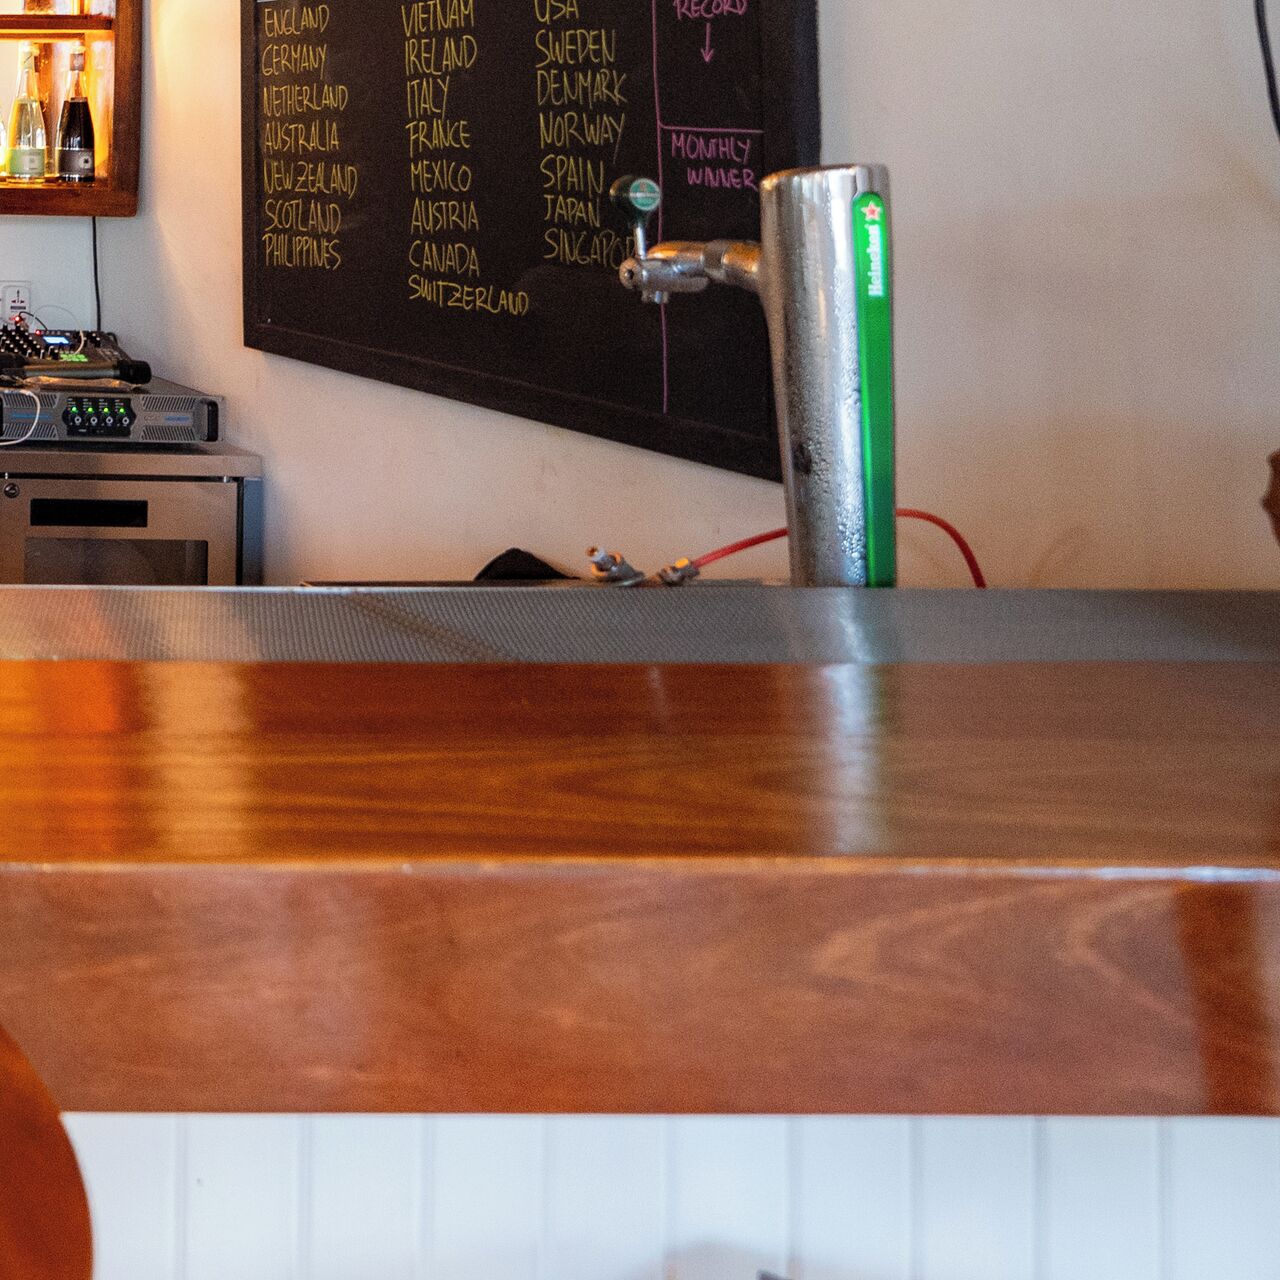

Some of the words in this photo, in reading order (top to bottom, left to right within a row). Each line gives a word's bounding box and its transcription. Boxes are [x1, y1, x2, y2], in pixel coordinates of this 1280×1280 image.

[264, 5, 330, 37] ENGLAND
[261, 43, 327, 80] GERMANY
[405, 35, 478, 76] IRELAND
[535, 29, 616, 68] SWEDEN
[263, 83, 349, 117] NETHERLAND
[407, 75, 450, 120] ITALY
[536, 68, 628, 110] DENMARK
[263, 119, 340, 155] AUSTRALIA
[405, 118, 471, 158] FRANCE
[539, 111, 626, 165] NORWAY
[671, 131, 751, 165] MONTHLY
[410, 159, 472, 192] MEXICO
[540, 154, 604, 198] SPAIN
[687, 166, 759, 193] WINNER
[264, 199, 342, 236] SCOTLAND
[410, 196, 480, 234] AUSTRIA
[543, 194, 601, 228] JAPAN
[262, 233, 342, 270] PHILIPPINES
[408, 240, 480, 277] CANADA
[866, 223, 884, 297] Heineken
[408, 274, 529, 317] SWITZERLAND
